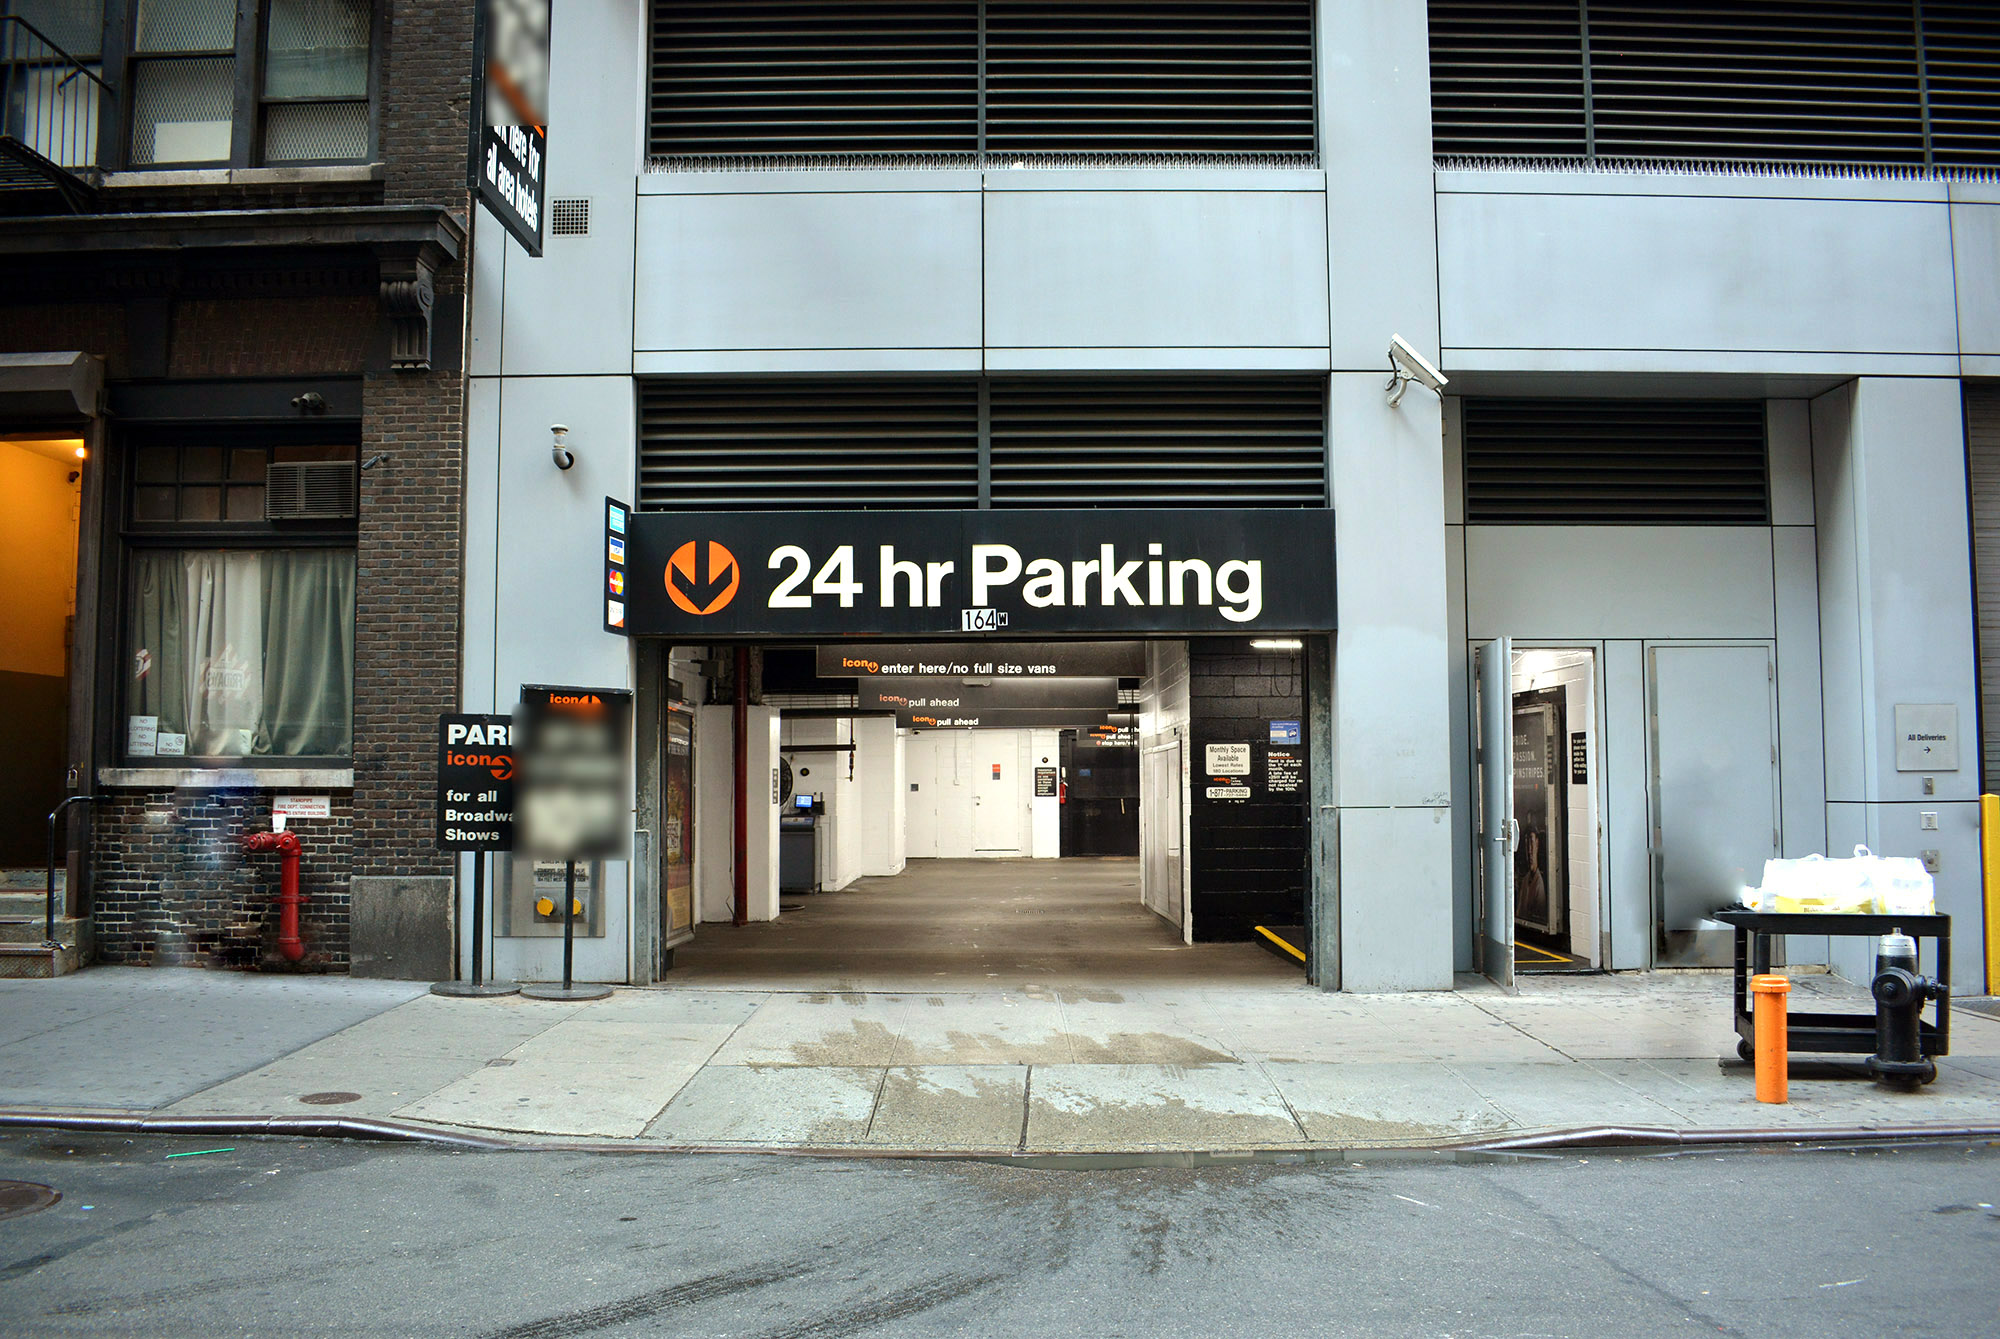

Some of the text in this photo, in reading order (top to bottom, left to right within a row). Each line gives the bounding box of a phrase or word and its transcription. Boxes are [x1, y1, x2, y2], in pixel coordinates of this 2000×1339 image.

[528, 133, 541, 183] for
[486, 142, 498, 186] all
[497, 161, 515, 207] area
[515, 172, 538, 233] hotels
[767, 543, 1262, 623] 24 hr Parking
[965, 610, 996, 630] 164
[842, 657, 1057, 674] icon enter here/no full size vans
[550, 693, 579, 705] icon
[879, 693, 960, 709] icon pull ahead
[912, 715, 979, 727] icon pull ahead
[1907, 733, 1947, 741] All Deliveries
[1209, 745, 1247, 754] Monthly Space
[447, 750, 492, 766] icon
[1217, 754, 1240, 762] Available
[446, 789, 498, 802] for all
[445, 809, 514, 822] Broadwa
[445, 828, 500, 841] Shows
